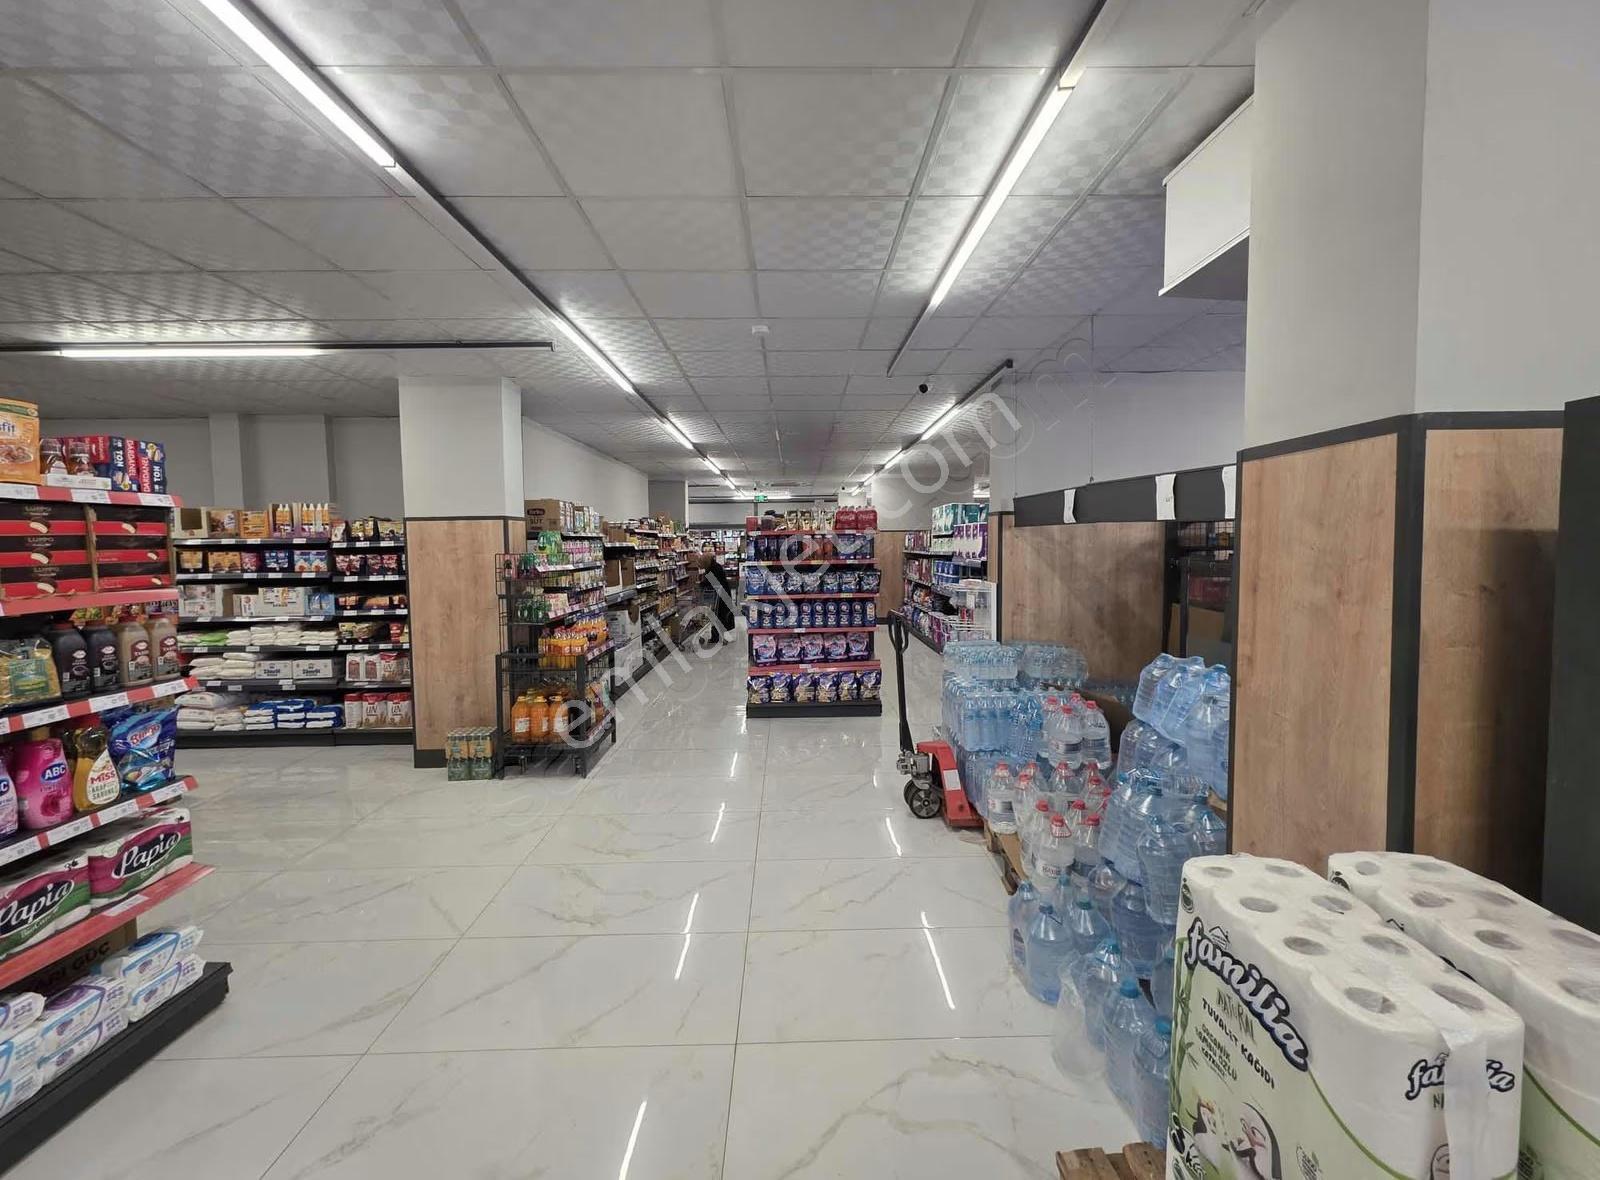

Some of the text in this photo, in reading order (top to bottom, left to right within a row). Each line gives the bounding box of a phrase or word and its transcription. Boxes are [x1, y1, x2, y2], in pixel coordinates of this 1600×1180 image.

[116, 450, 125, 468] TON
[127, 440, 137, 477] DARDANEL
[153, 465, 161, 482] TON
[44, 763, 66, 781] ABC
[112, 833, 179, 878] Papia
[0, 880, 72, 927] Papia
[1186, 918, 1308, 1072] familia
[1202, 998, 1238, 1046] TUVALET
[1241, 1043, 1275, 1090] KAĞIDI
